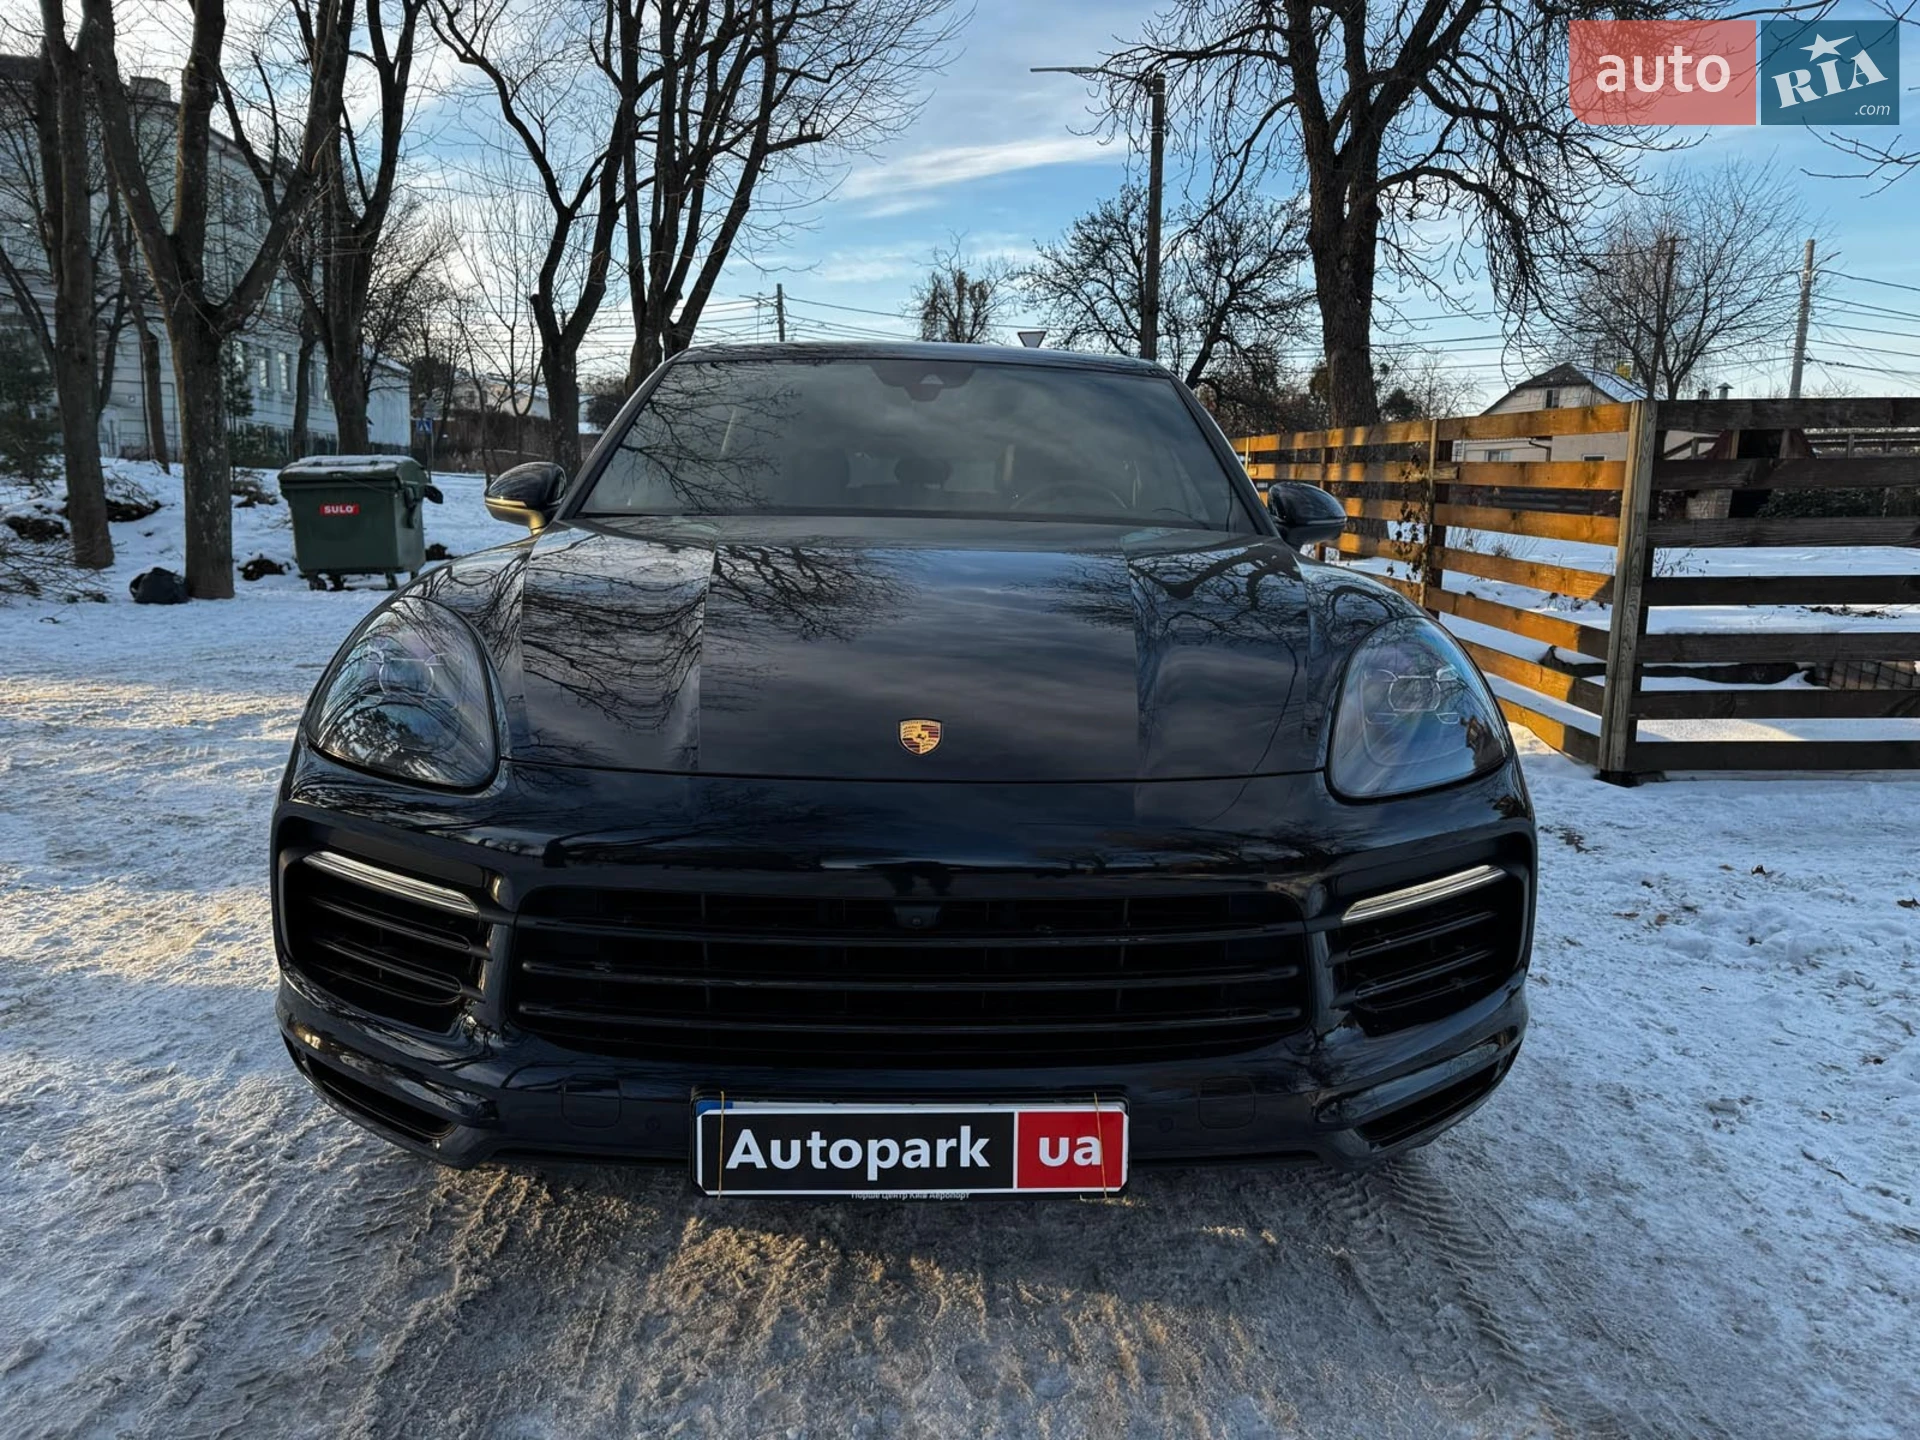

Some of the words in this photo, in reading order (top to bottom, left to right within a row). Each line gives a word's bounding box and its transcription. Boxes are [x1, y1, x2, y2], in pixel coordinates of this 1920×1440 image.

[324, 505, 354, 514] SULO
[725, 1125, 990, 1181] Autopark
[1038, 1136, 1101, 1167] ua
